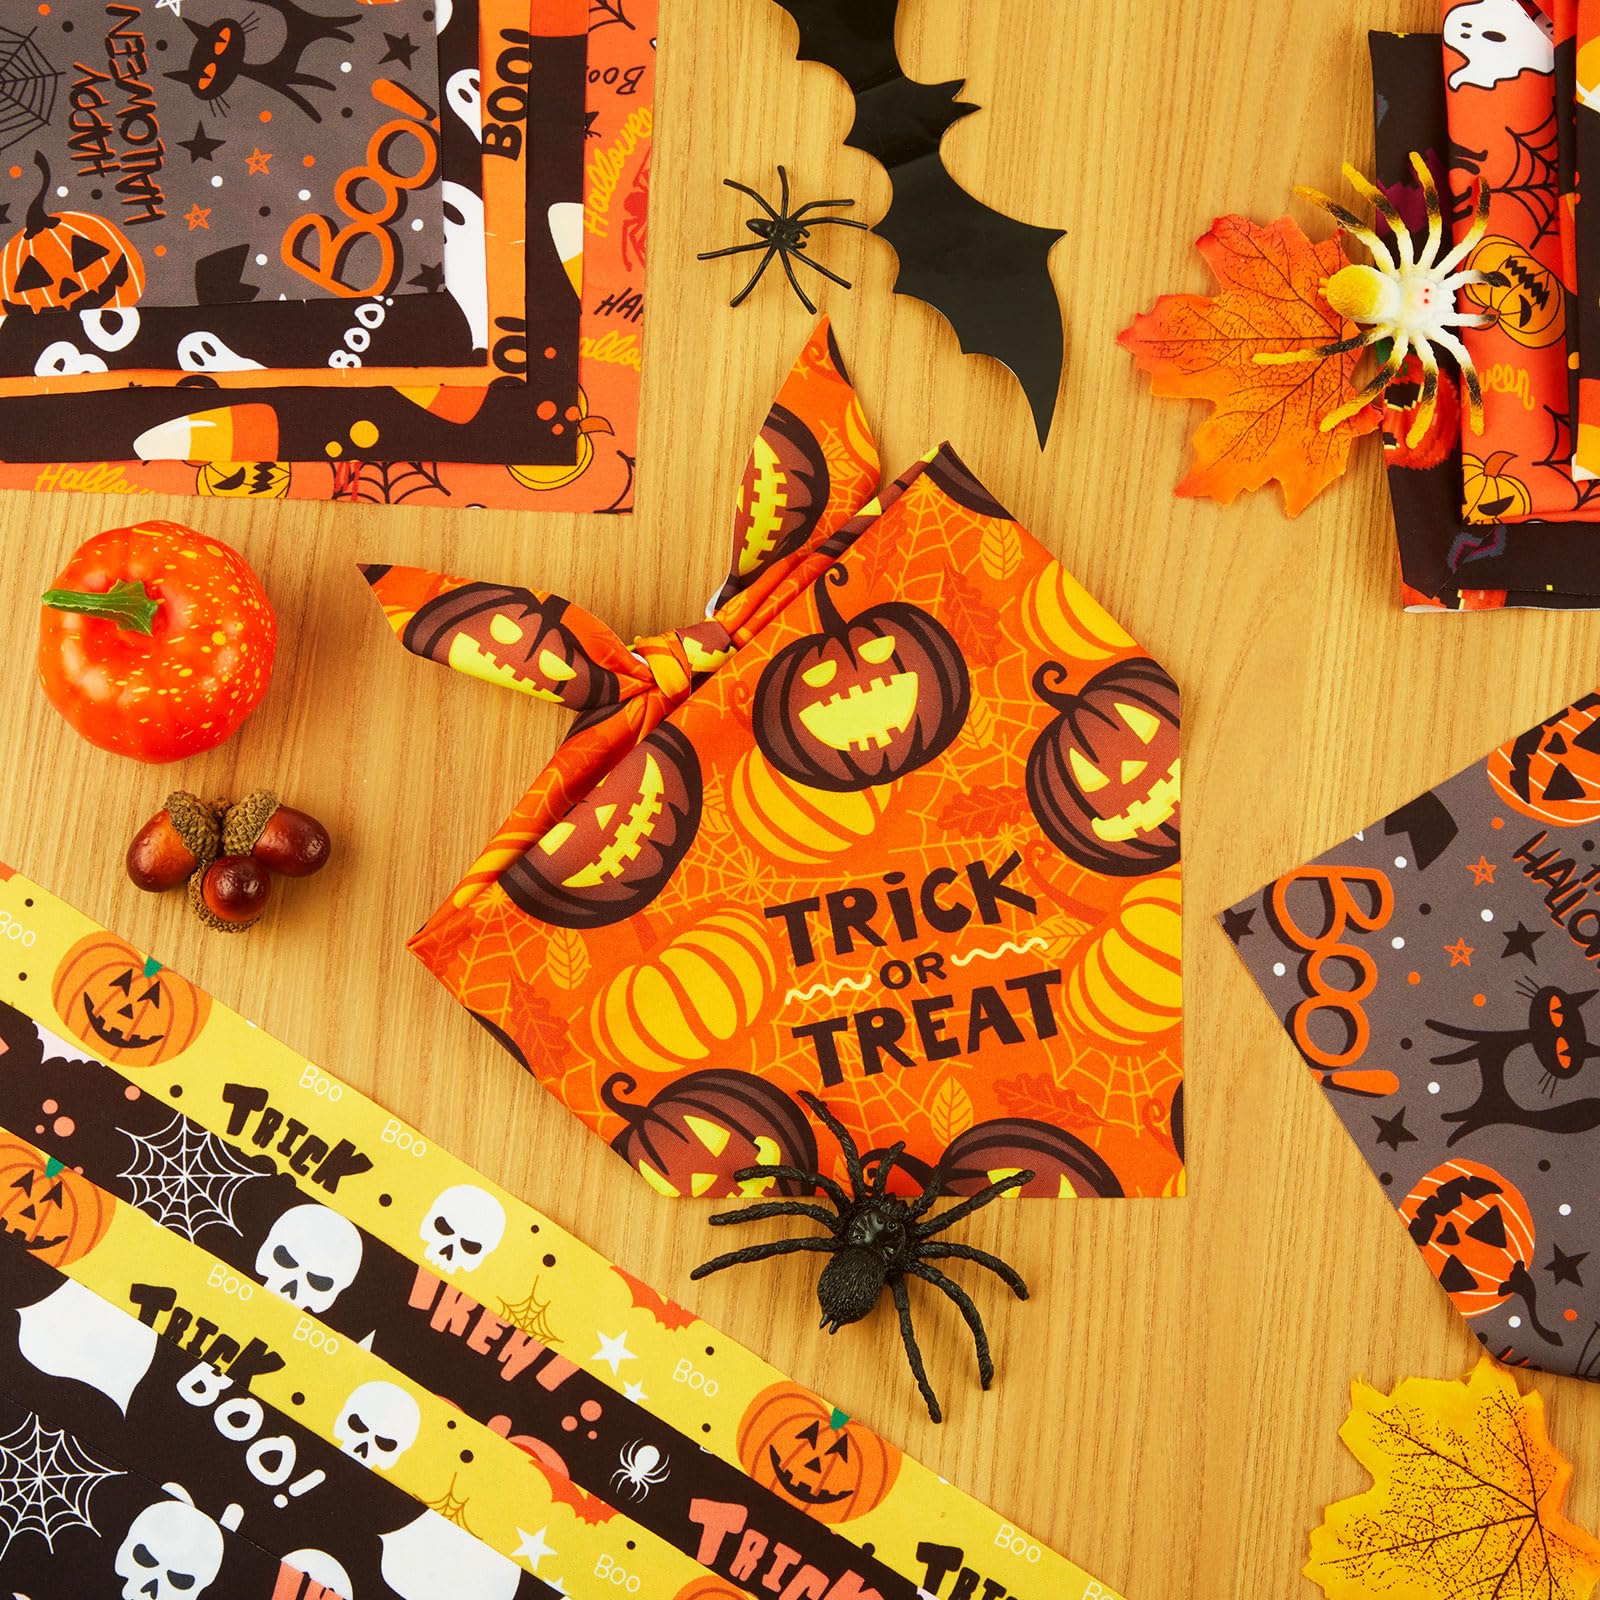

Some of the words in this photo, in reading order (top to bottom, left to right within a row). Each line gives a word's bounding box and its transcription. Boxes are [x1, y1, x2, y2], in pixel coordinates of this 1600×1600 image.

[482, 29, 533, 161] BOO!
[586, 65, 646, 95] Boo
[68, 61, 120, 177] HAPPY
[105, 3, 167, 226] HALLOWEEN
[879, 952, 947, 989] OR
[791, 969, 1062, 1088] TREAT
[298, 1064, 343, 1103] Boo
[380, 1118, 427, 1158] Boo
[207, 1263, 253, 1301] Boo
[292, 1316, 339, 1355] Boo
[672, 1358, 719, 1398] Boo
[994, 1523, 1041, 1564] Boo
[593, 1554, 641, 1593] Boo
